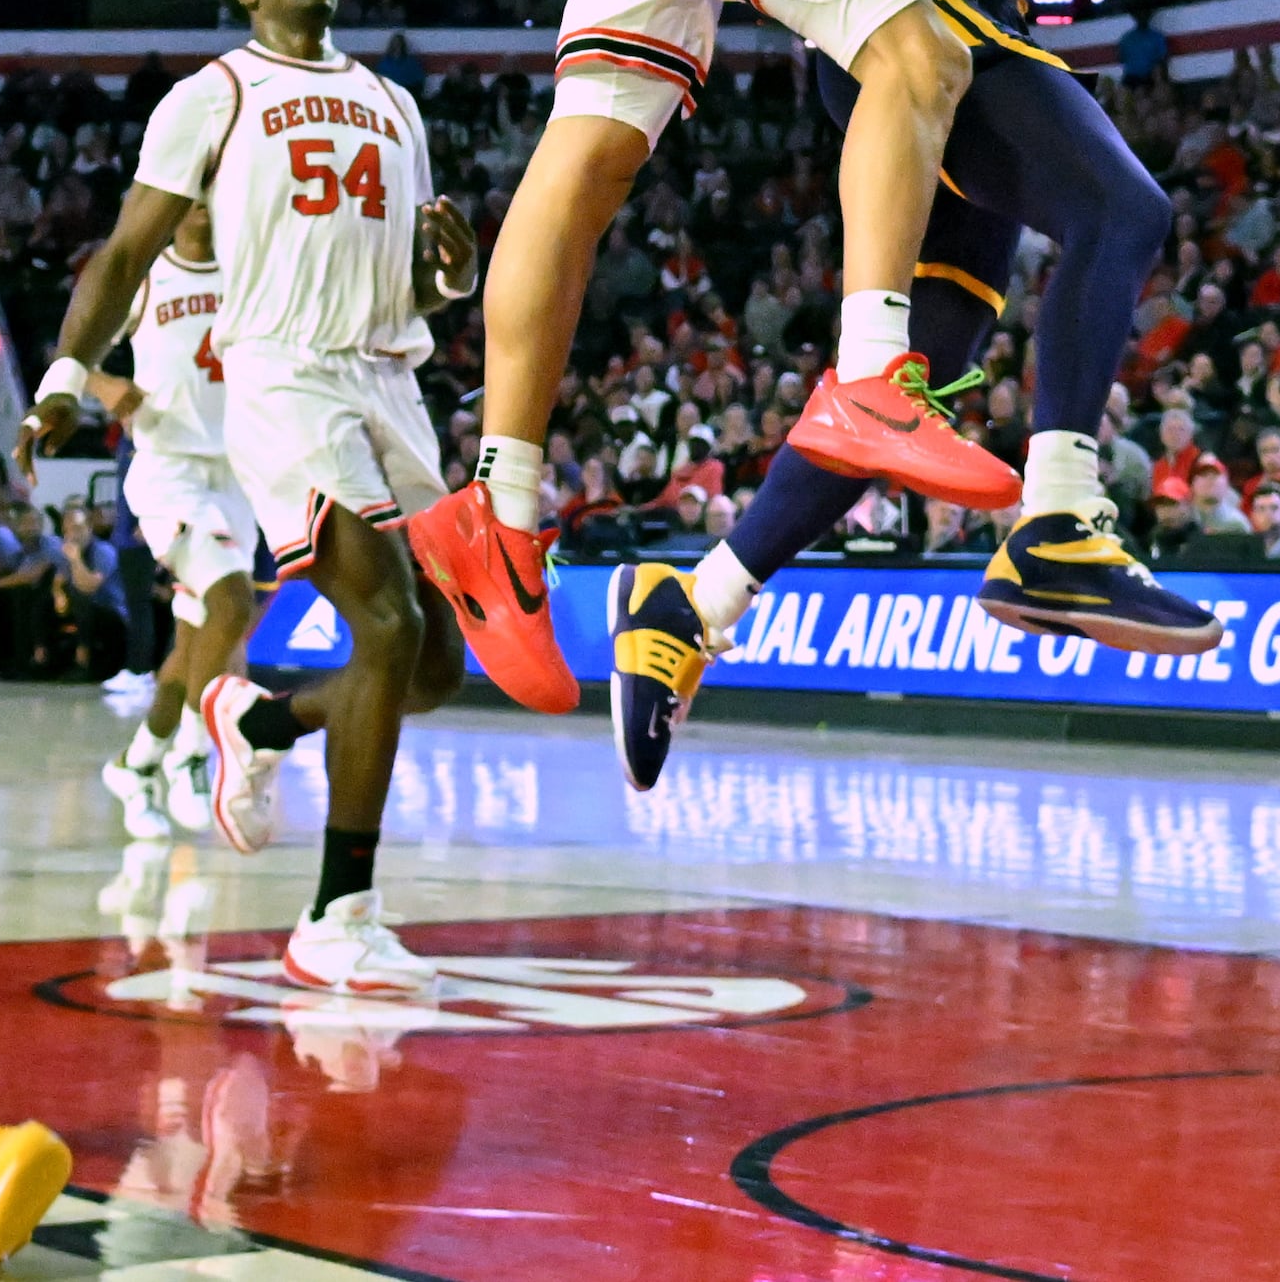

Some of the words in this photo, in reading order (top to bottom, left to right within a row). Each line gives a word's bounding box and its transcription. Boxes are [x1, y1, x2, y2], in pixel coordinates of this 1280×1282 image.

[262, 96, 402, 148] GEORGIA
[288, 139, 386, 220] 54
[156, 293, 223, 327] GEOR
[824, 593, 1027, 674] AIRLINE
